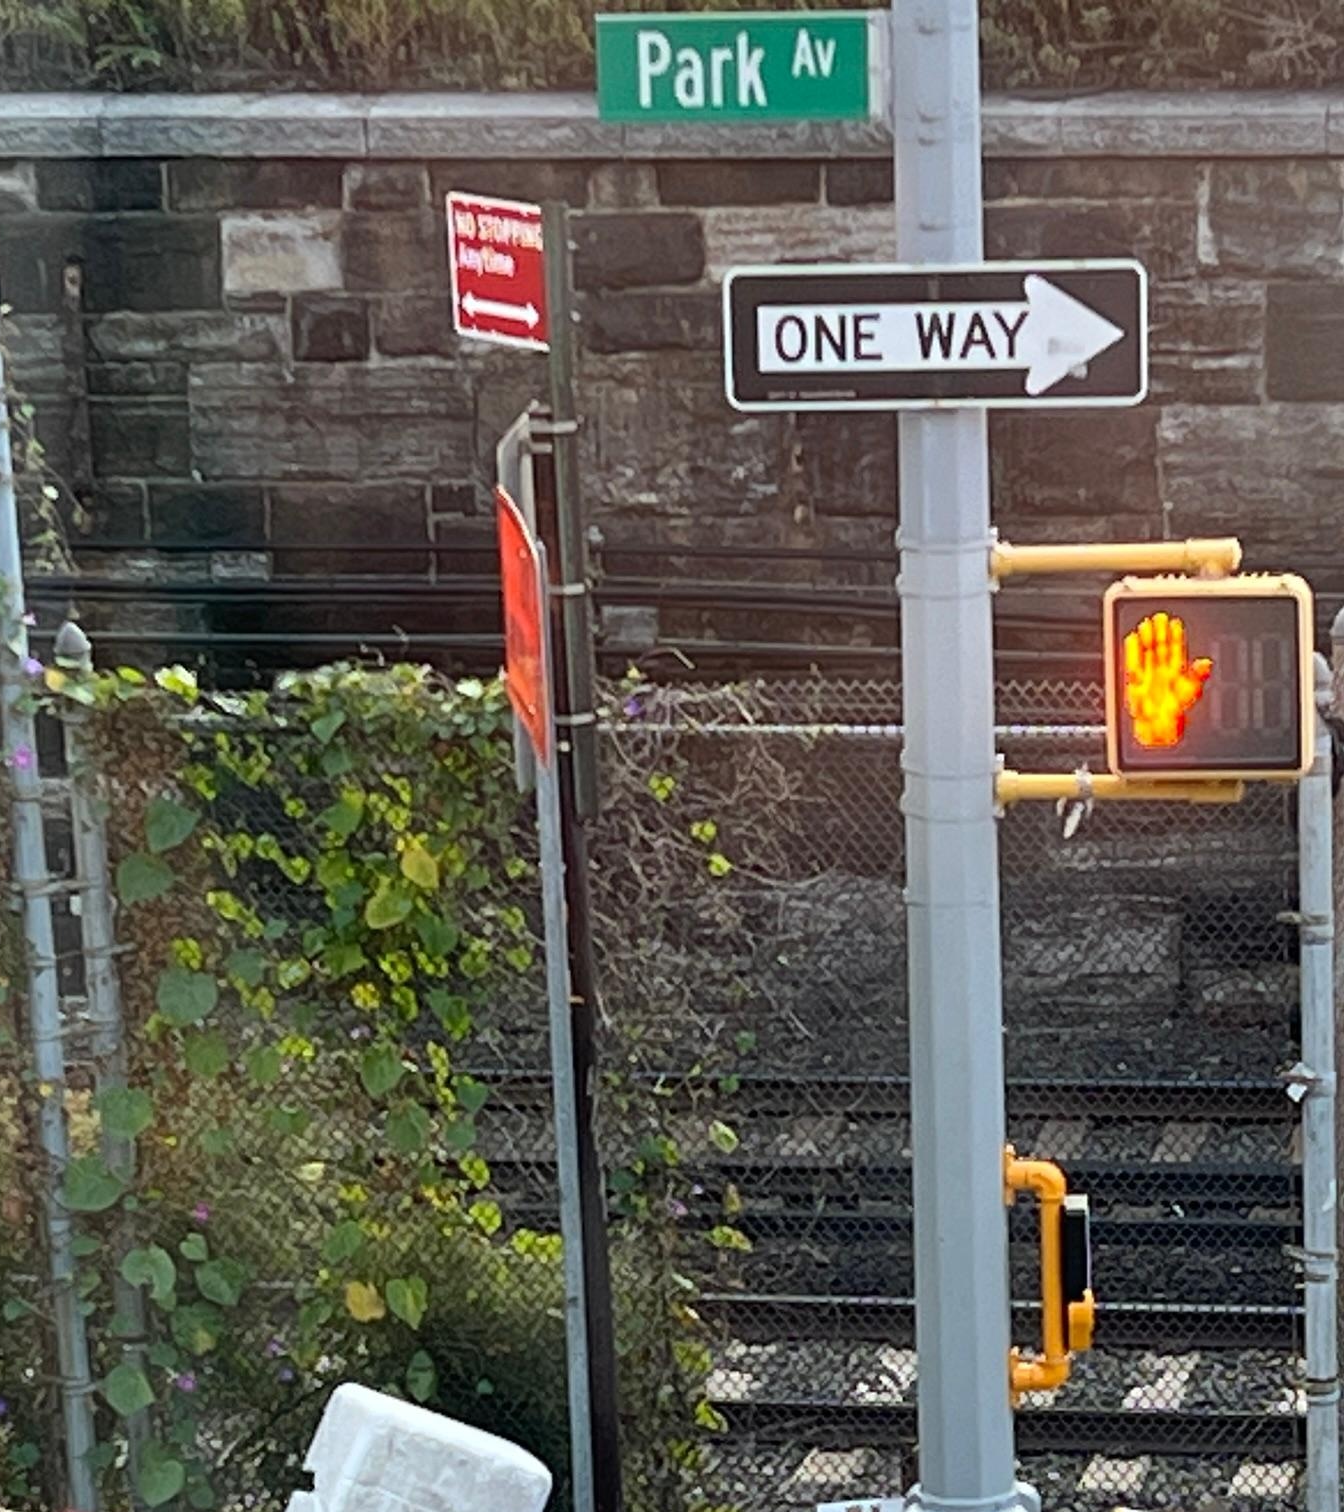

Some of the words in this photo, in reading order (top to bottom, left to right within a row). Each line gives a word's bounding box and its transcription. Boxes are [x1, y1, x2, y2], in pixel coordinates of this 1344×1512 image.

[636, 29, 768, 109] Park
[791, 28, 837, 78] Av
[455, 209, 476, 240] NO
[774, 313, 884, 363] ONE
[915, 311, 1030, 360] WAY
